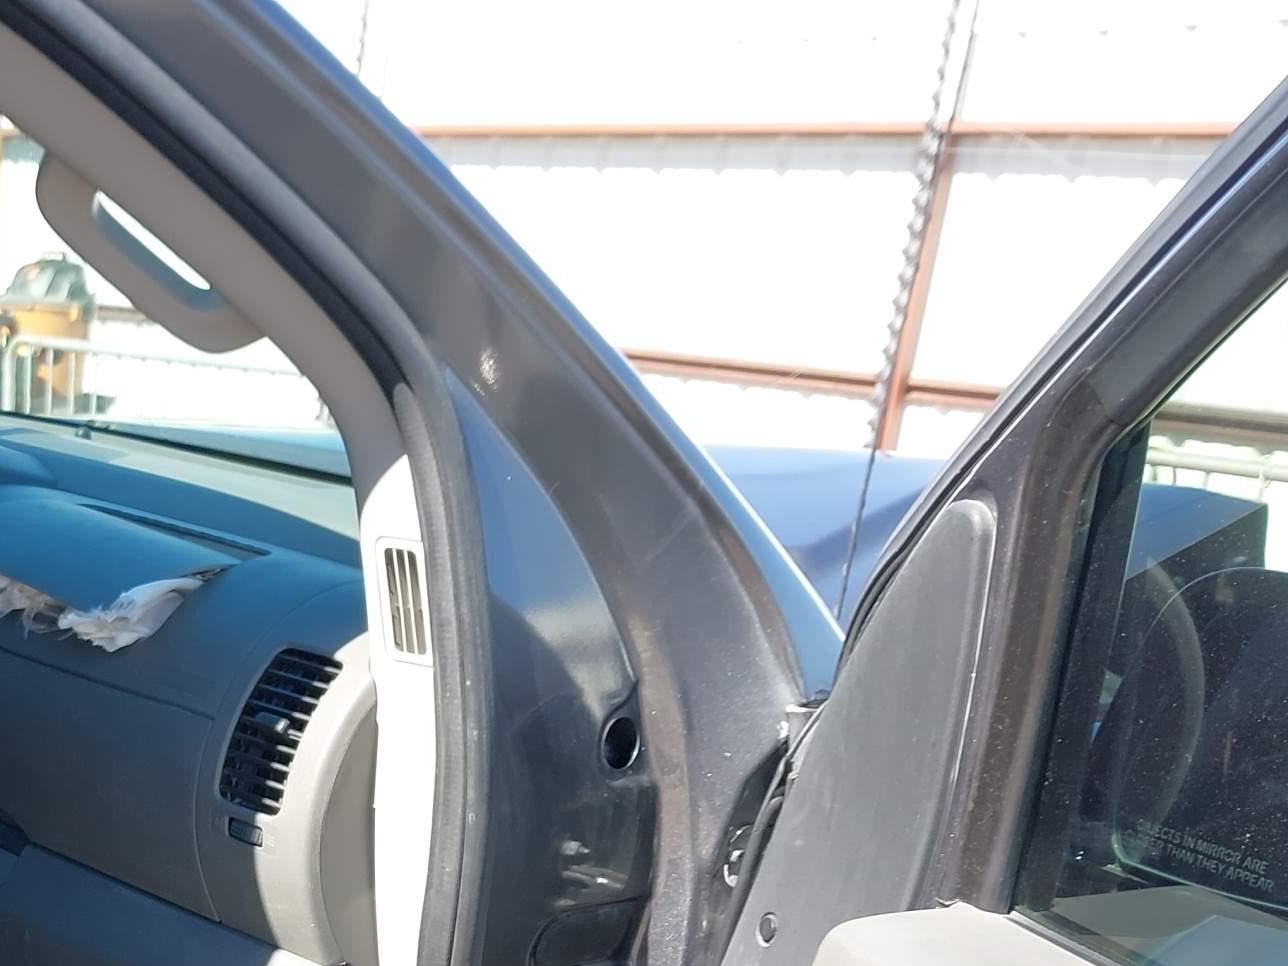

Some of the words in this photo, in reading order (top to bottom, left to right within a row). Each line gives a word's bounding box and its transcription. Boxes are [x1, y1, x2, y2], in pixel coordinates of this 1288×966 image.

[1136, 818, 1182, 845] OECTS
[1182, 833, 1196, 849] IN
[1195, 838, 1241, 864] MIRROR
[1242, 856, 1270, 875] ARE
[1166, 844, 1195, 864] THAN
[1196, 854, 1226, 874] THEY
[1224, 866, 1275, 894] APPEAR
